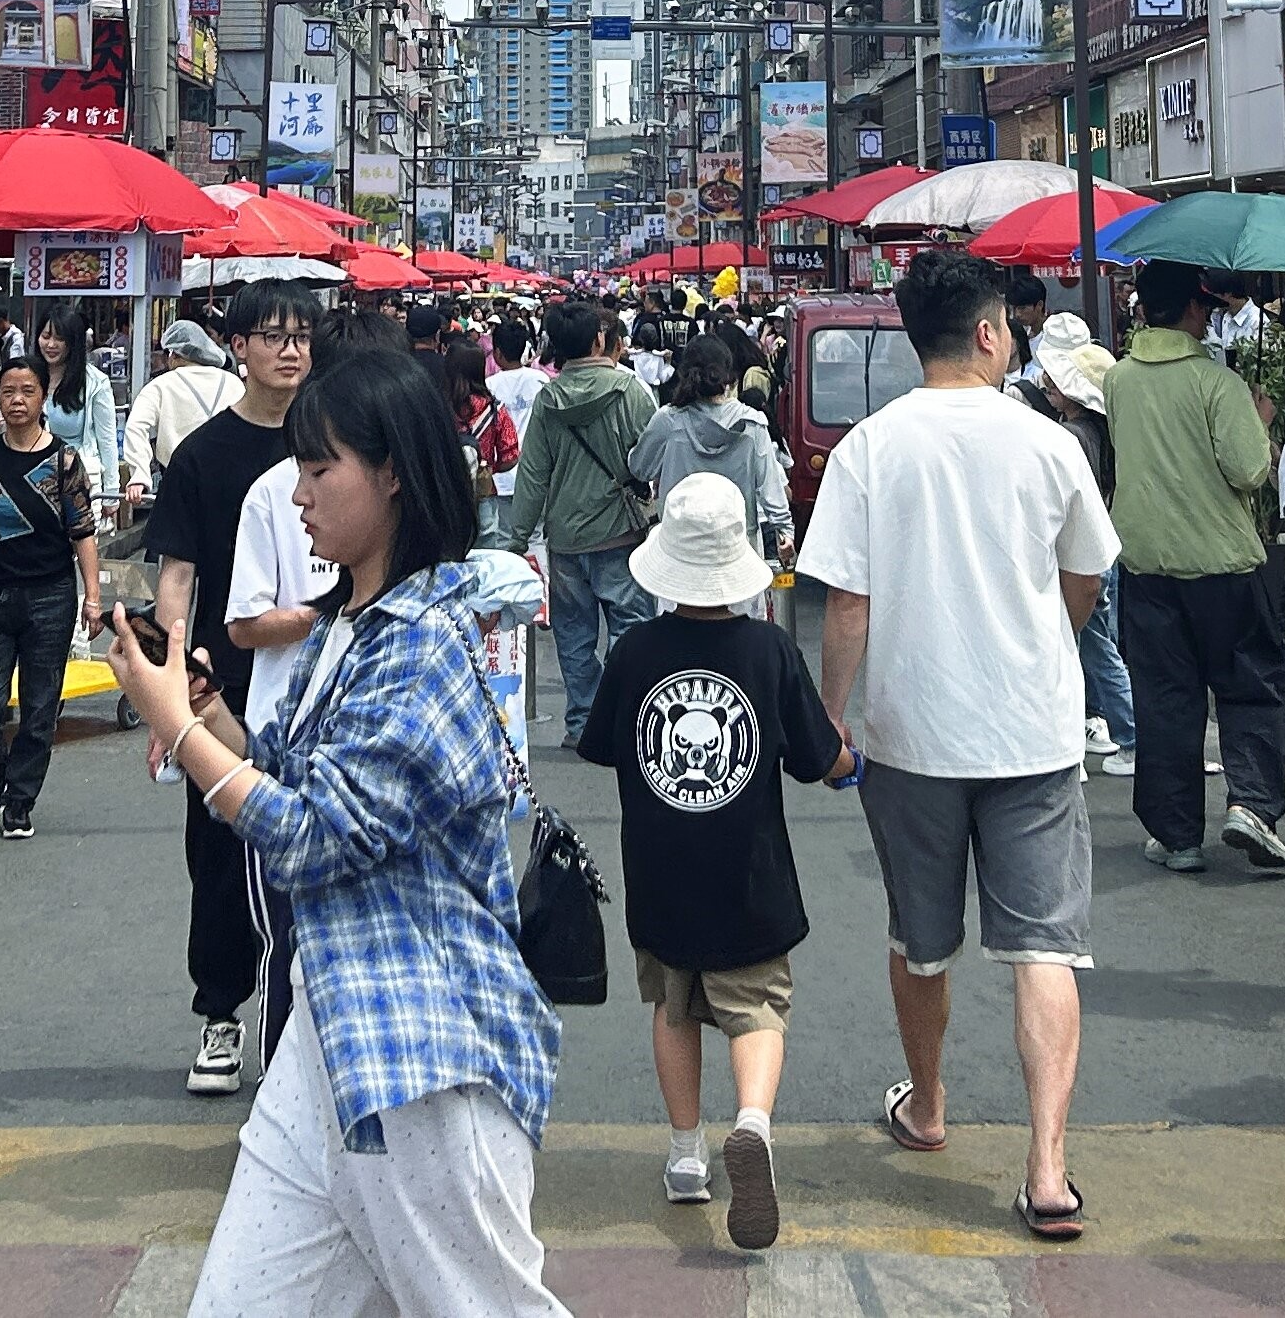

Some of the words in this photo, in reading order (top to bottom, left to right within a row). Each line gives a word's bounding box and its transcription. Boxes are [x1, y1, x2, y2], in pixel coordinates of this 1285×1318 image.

[281, 92, 323, 112] 十里
[42, 107, 119, 126] 今日皆宜
[279, 115, 323, 137] 河廊
[949, 130, 981, 144] 西秀区
[311, 563, 340, 574] ANT
[653, 679, 745, 725] HIPANDA
[646, 759, 677, 794] KEEP
[678, 784, 725, 803] CLEAN
[728, 763, 748, 792] AIR
